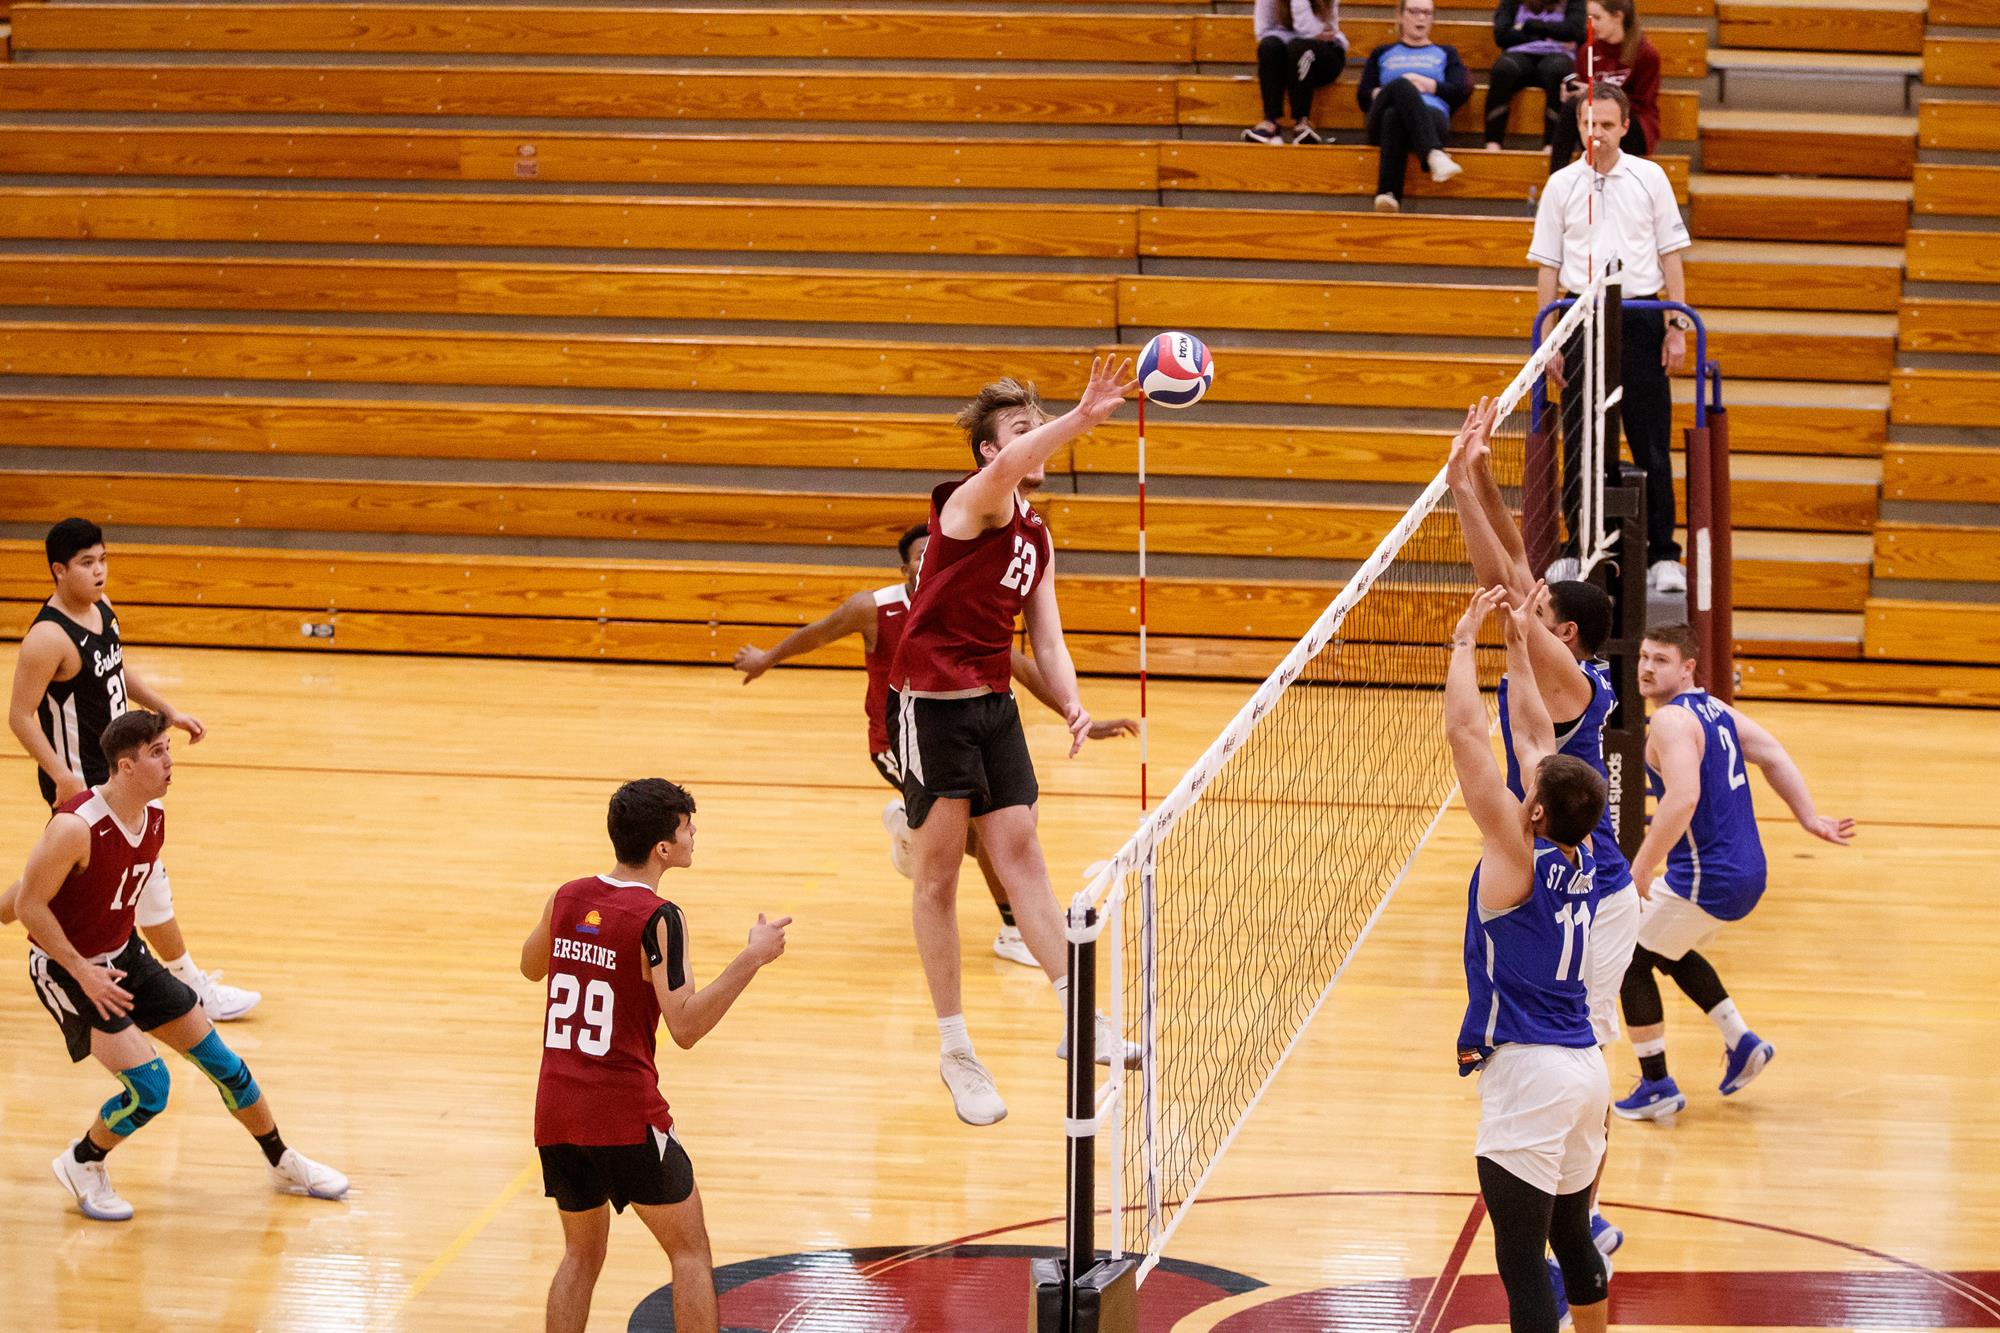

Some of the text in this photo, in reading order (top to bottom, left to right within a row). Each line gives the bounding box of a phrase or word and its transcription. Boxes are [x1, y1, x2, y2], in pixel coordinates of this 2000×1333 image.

[1000, 535, 1037, 597] 23
[107, 668, 128, 720] 2
[1607, 752, 1623, 804] sports
[1718, 725, 1746, 791] 2
[110, 863, 151, 911] 17
[553, 937, 617, 971] ERSKINE
[1555, 901, 1592, 981] 11
[545, 972, 615, 1057] 29
